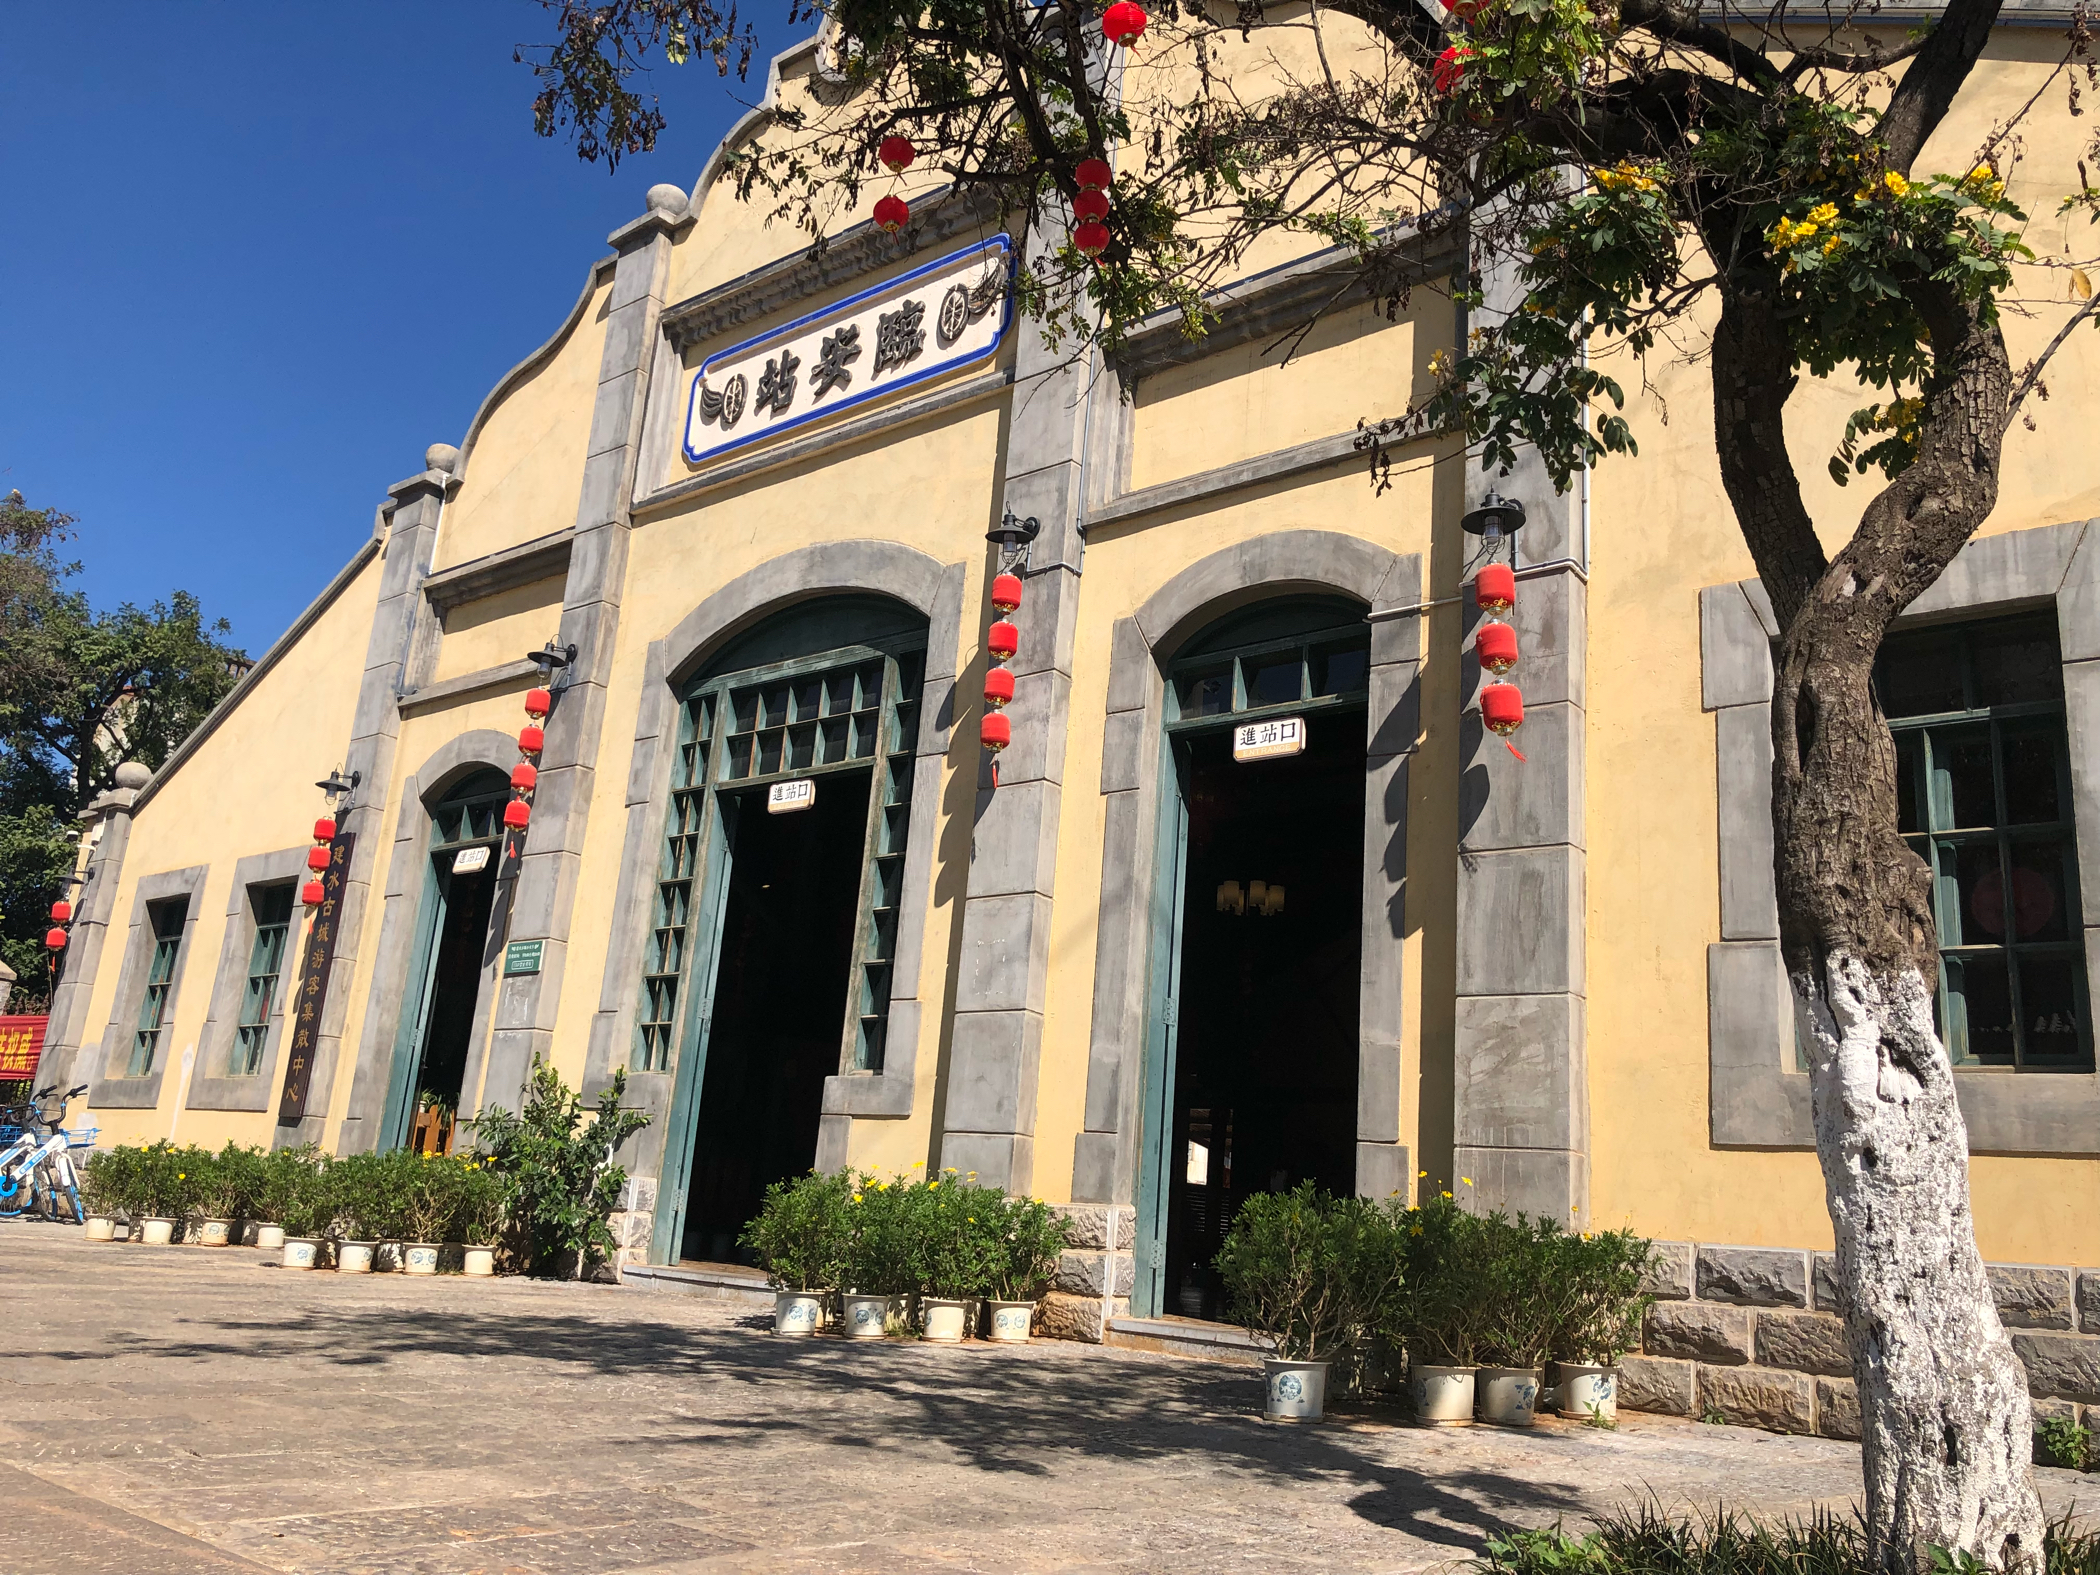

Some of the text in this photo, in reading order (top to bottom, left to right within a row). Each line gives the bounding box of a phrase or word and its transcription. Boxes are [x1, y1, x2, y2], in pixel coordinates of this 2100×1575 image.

[1240, 722, 1296, 746] 進站口
[1242, 743, 1292, 757] ENTRANCE
[772, 783, 809, 801] 進站口
